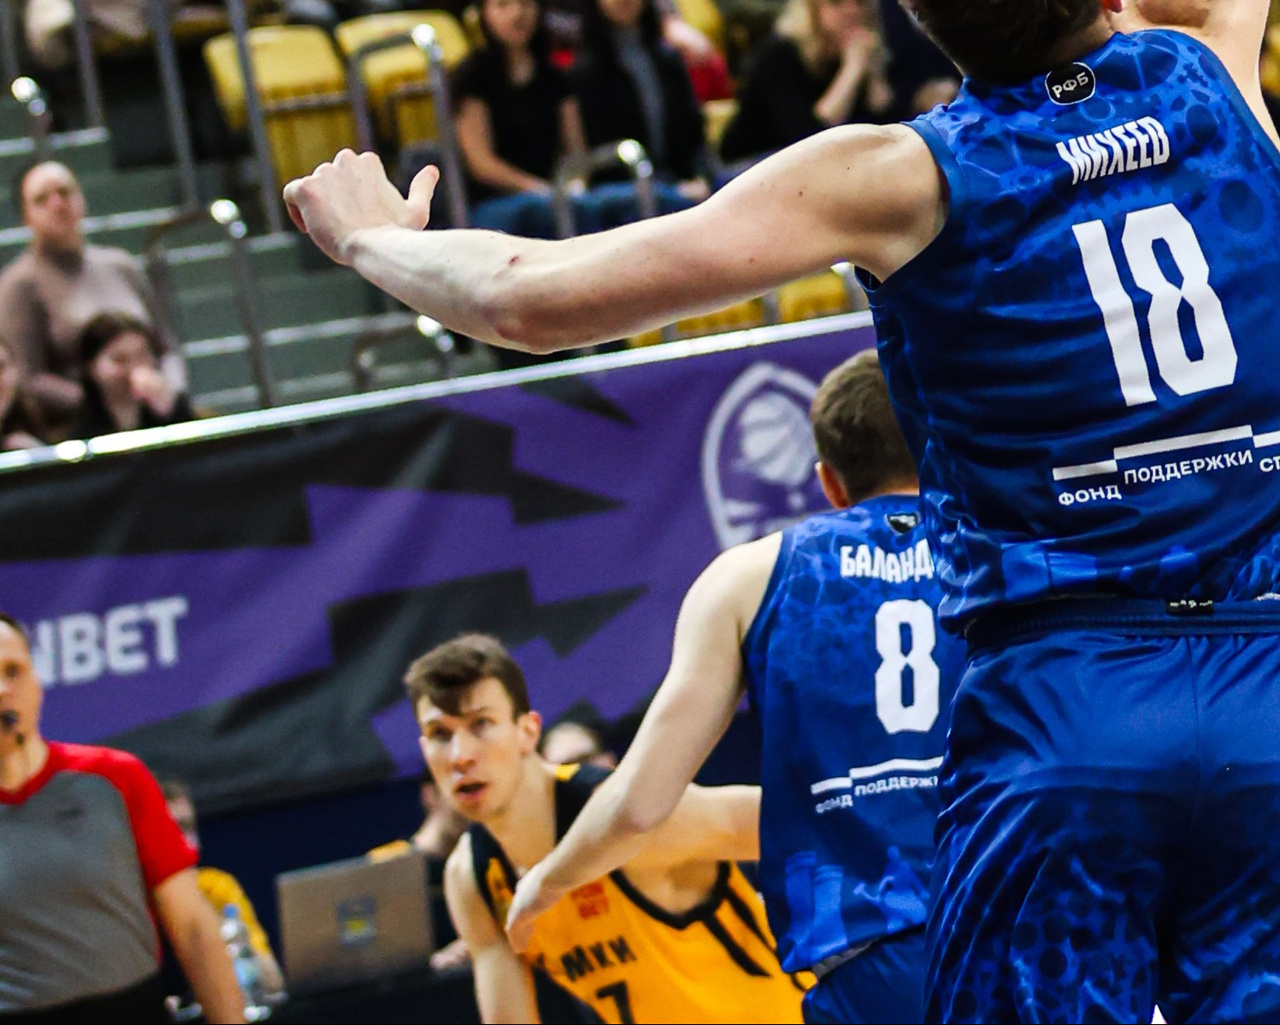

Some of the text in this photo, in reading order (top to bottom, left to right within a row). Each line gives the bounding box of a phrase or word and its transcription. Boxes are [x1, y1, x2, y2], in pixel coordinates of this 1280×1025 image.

[1052, 71, 1089, 98] РФБ
[1071, 203, 1238, 407] 18
[1058, 484, 1122, 506] ФОНД
[1123, 450, 1254, 485] ПОДДЕРЖКИ
[874, 598, 940, 735] 8
